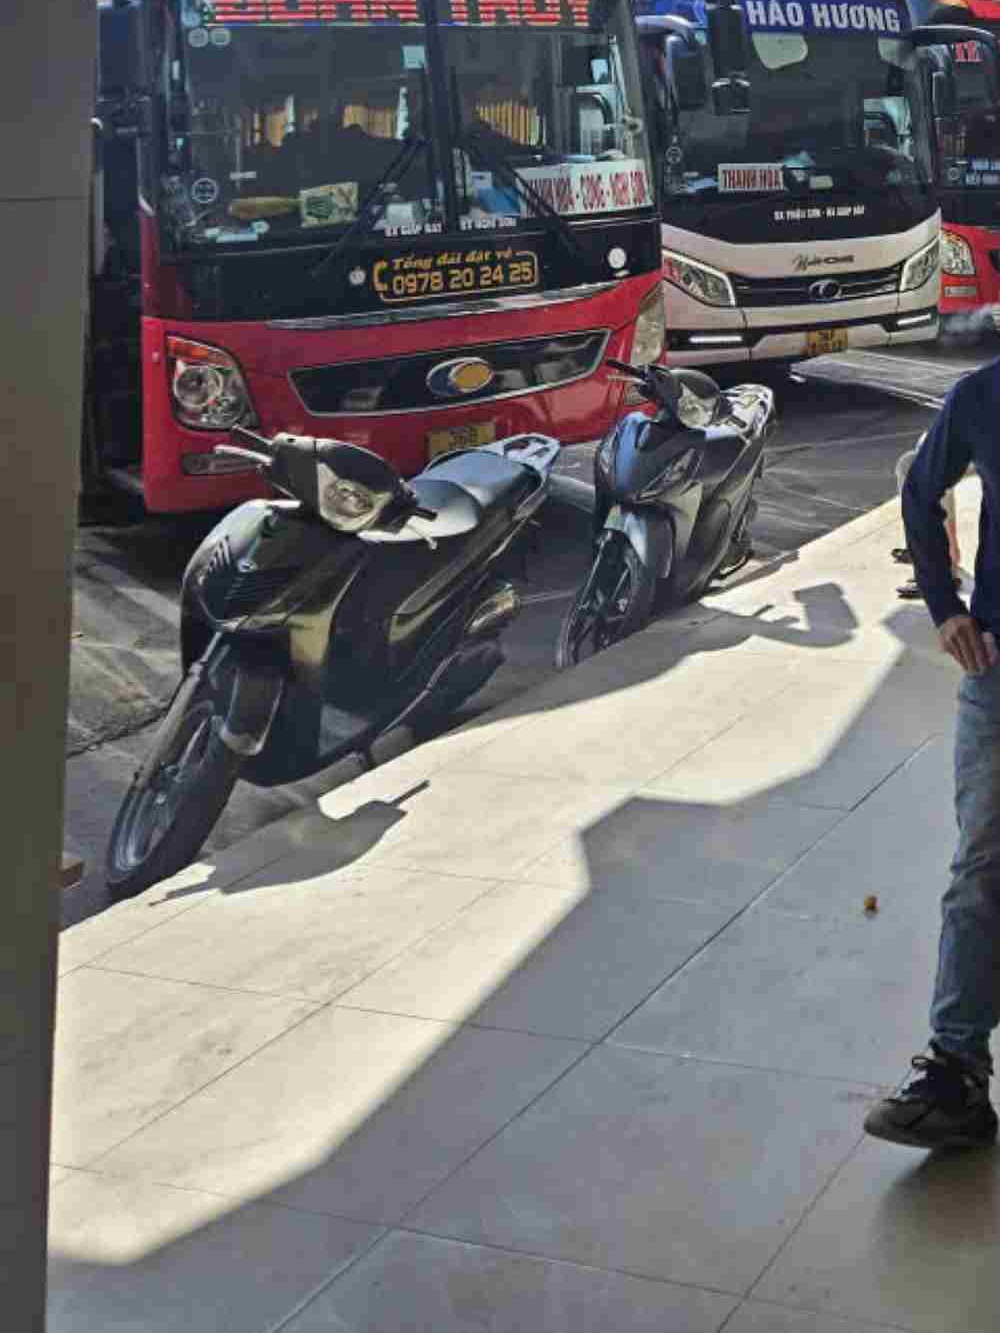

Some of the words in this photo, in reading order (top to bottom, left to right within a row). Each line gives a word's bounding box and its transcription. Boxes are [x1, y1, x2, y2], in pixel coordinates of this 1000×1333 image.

[811, 2, 901, 33] HƯƠNG
[391, 252, 432, 271] Tổng
[392, 270, 443, 297] 0978
[449, 267, 475, 290] 20
[480, 264, 503, 286] 24
[509, 260, 533, 284] 25
